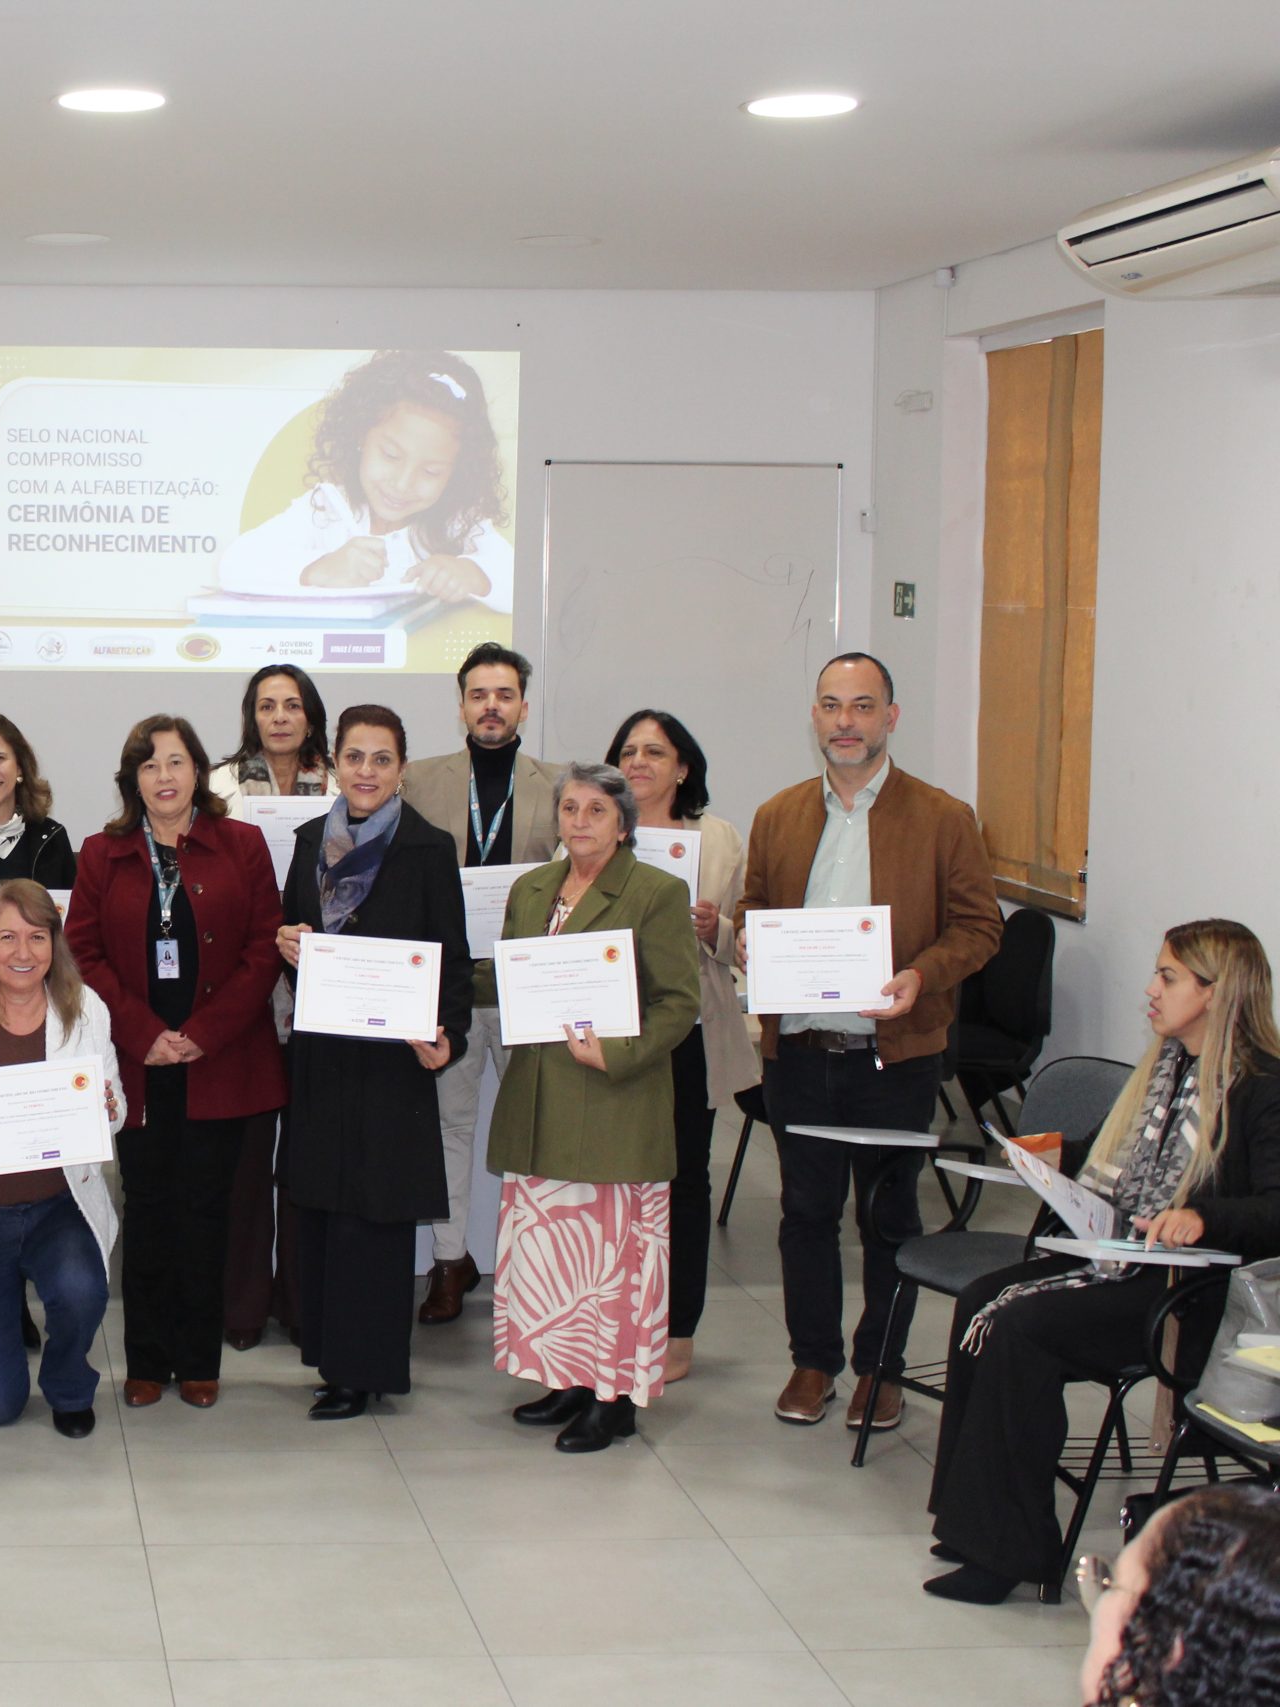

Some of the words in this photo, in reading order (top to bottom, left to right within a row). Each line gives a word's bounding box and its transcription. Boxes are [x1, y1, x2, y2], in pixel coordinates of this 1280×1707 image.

[6, 428, 51, 444] SELO
[56, 429, 149, 444] NACIONAL
[6, 451, 143, 467] COMPROMISSO
[6, 479, 48, 495] COM
[53, 480, 66, 495] A
[71, 477, 220, 500] ALFABETIZAÇÃO:
[7, 500, 135, 524] CERIMÔNIA
[141, 506, 170, 524] DE
[7, 533, 217, 554] RECONHECIMENTO
[279, 640, 313, 648] GOVERNO
